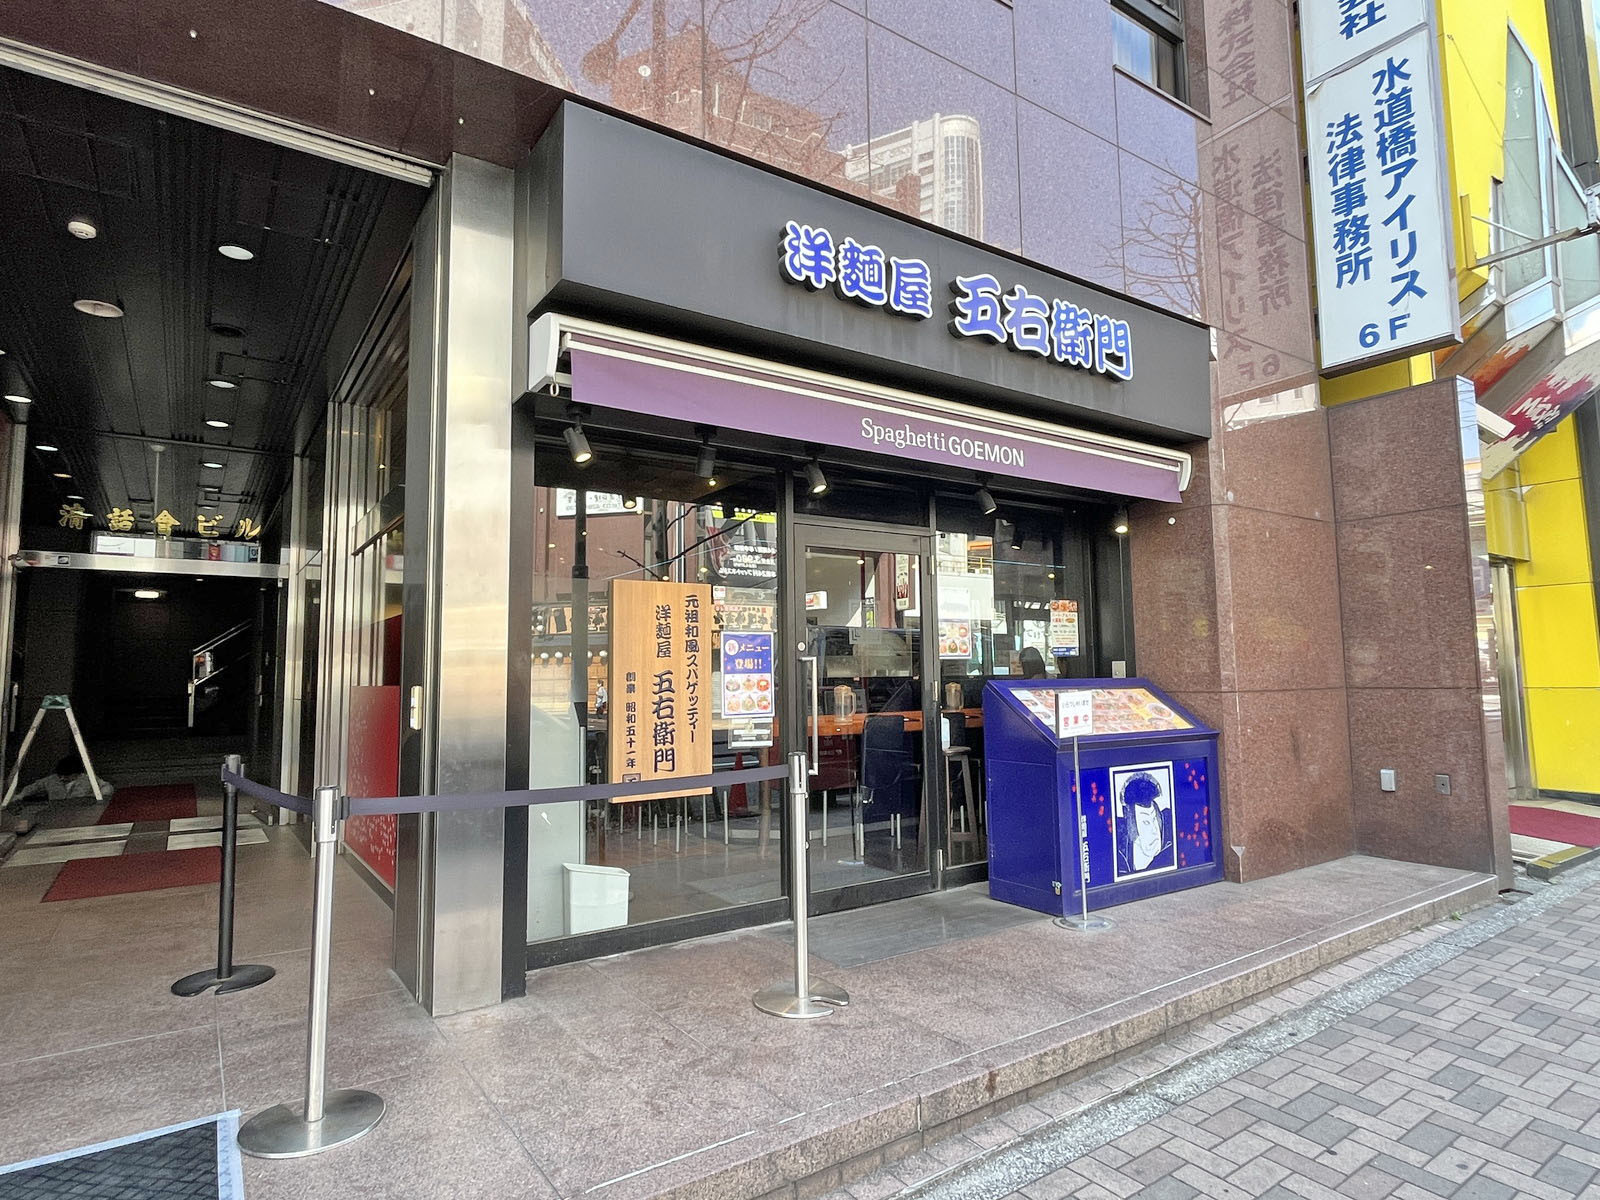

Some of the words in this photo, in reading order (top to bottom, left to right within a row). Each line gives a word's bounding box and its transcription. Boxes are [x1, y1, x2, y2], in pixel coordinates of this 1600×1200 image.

[1325, 113, 1373, 289] 法律事務所
[1372, 56, 1427, 306] 水道橋アイリス
[953, 273, 1134, 381] 五右衛門
[1359, 313, 1411, 348] 6F
[861, 417, 947, 452] Spaghetti
[948, 436, 1025, 468] GOEMON
[651, 669, 677, 773] 五右衛門
[684, 594, 700, 744] 元祖和風スパゲッティー
[625, 702, 636, 768] 昭和五十一年
